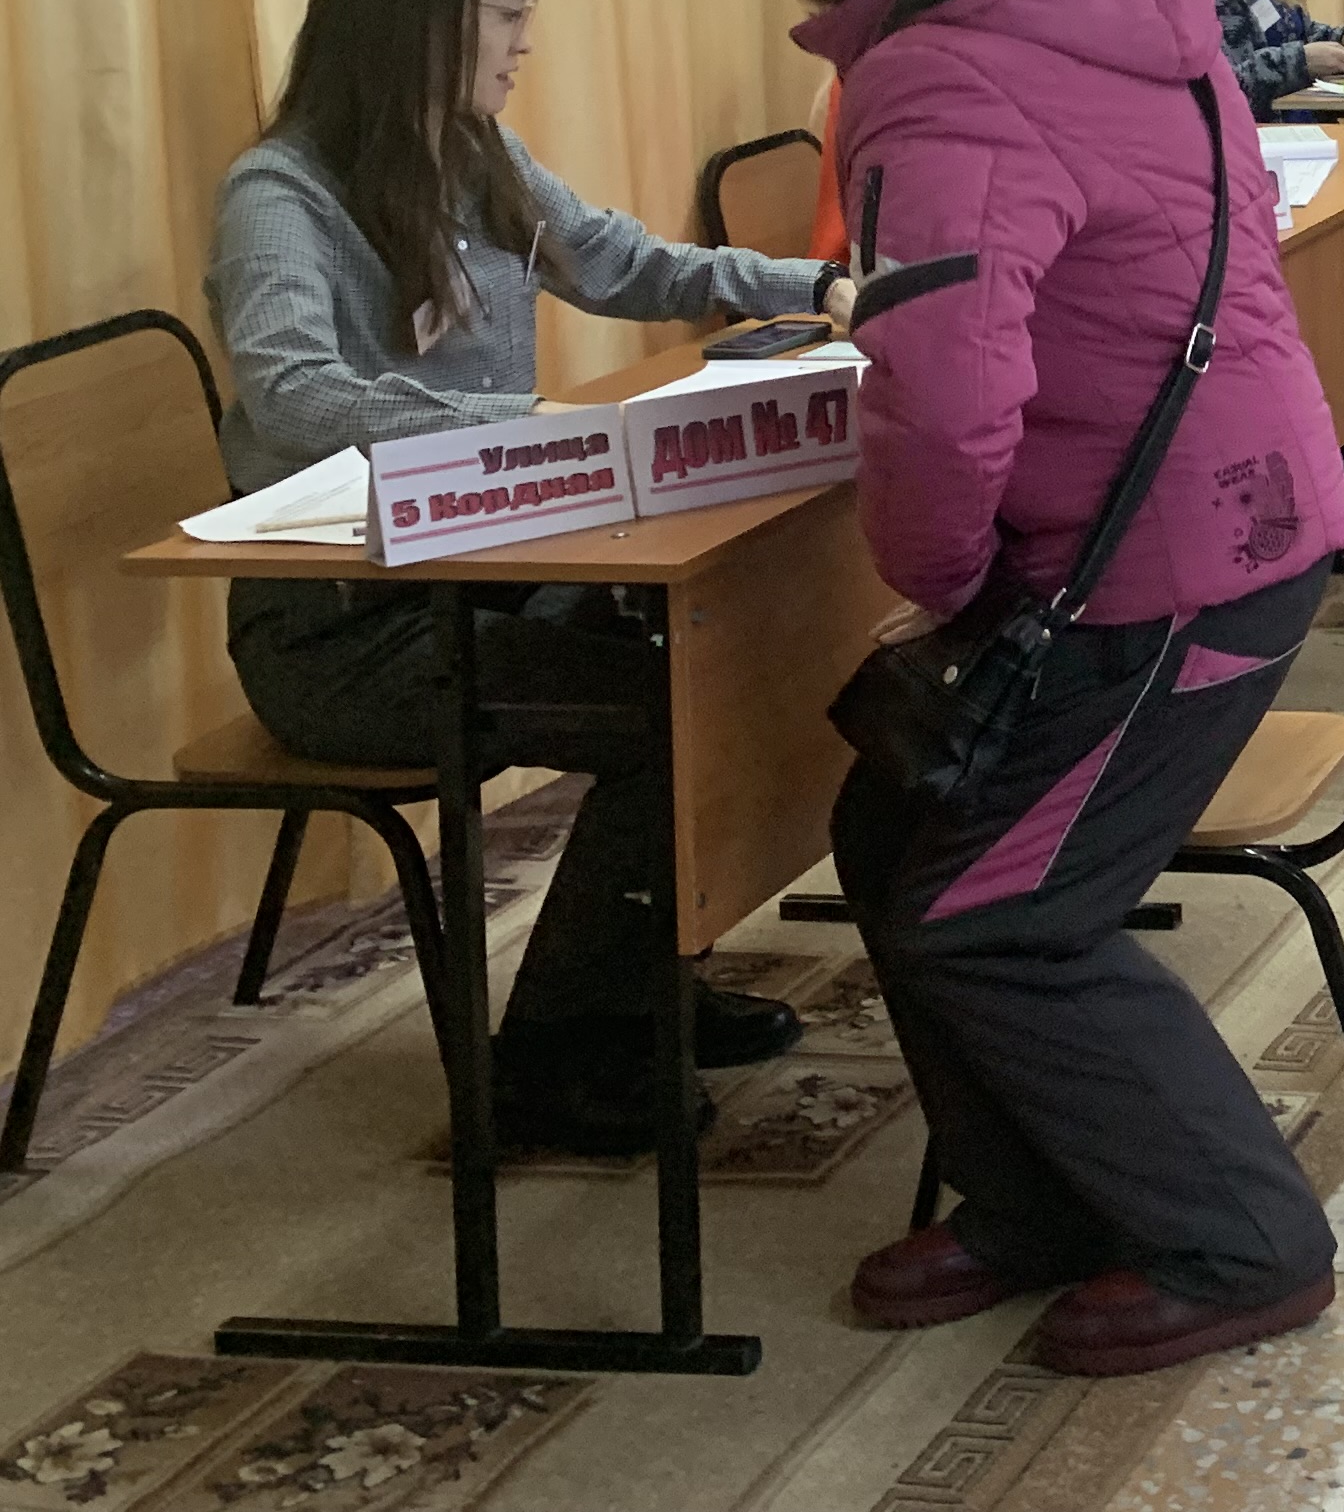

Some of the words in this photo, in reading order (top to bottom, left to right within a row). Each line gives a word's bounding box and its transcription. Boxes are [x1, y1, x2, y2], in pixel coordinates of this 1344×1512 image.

[478, 429, 610, 475] Улица
[650, 412, 748, 483] ДОМ
[750, 399, 801, 457] №
[804, 388, 850, 448] 47
[391, 499, 422, 528] 5
[429, 466, 615, 523] Кордная
